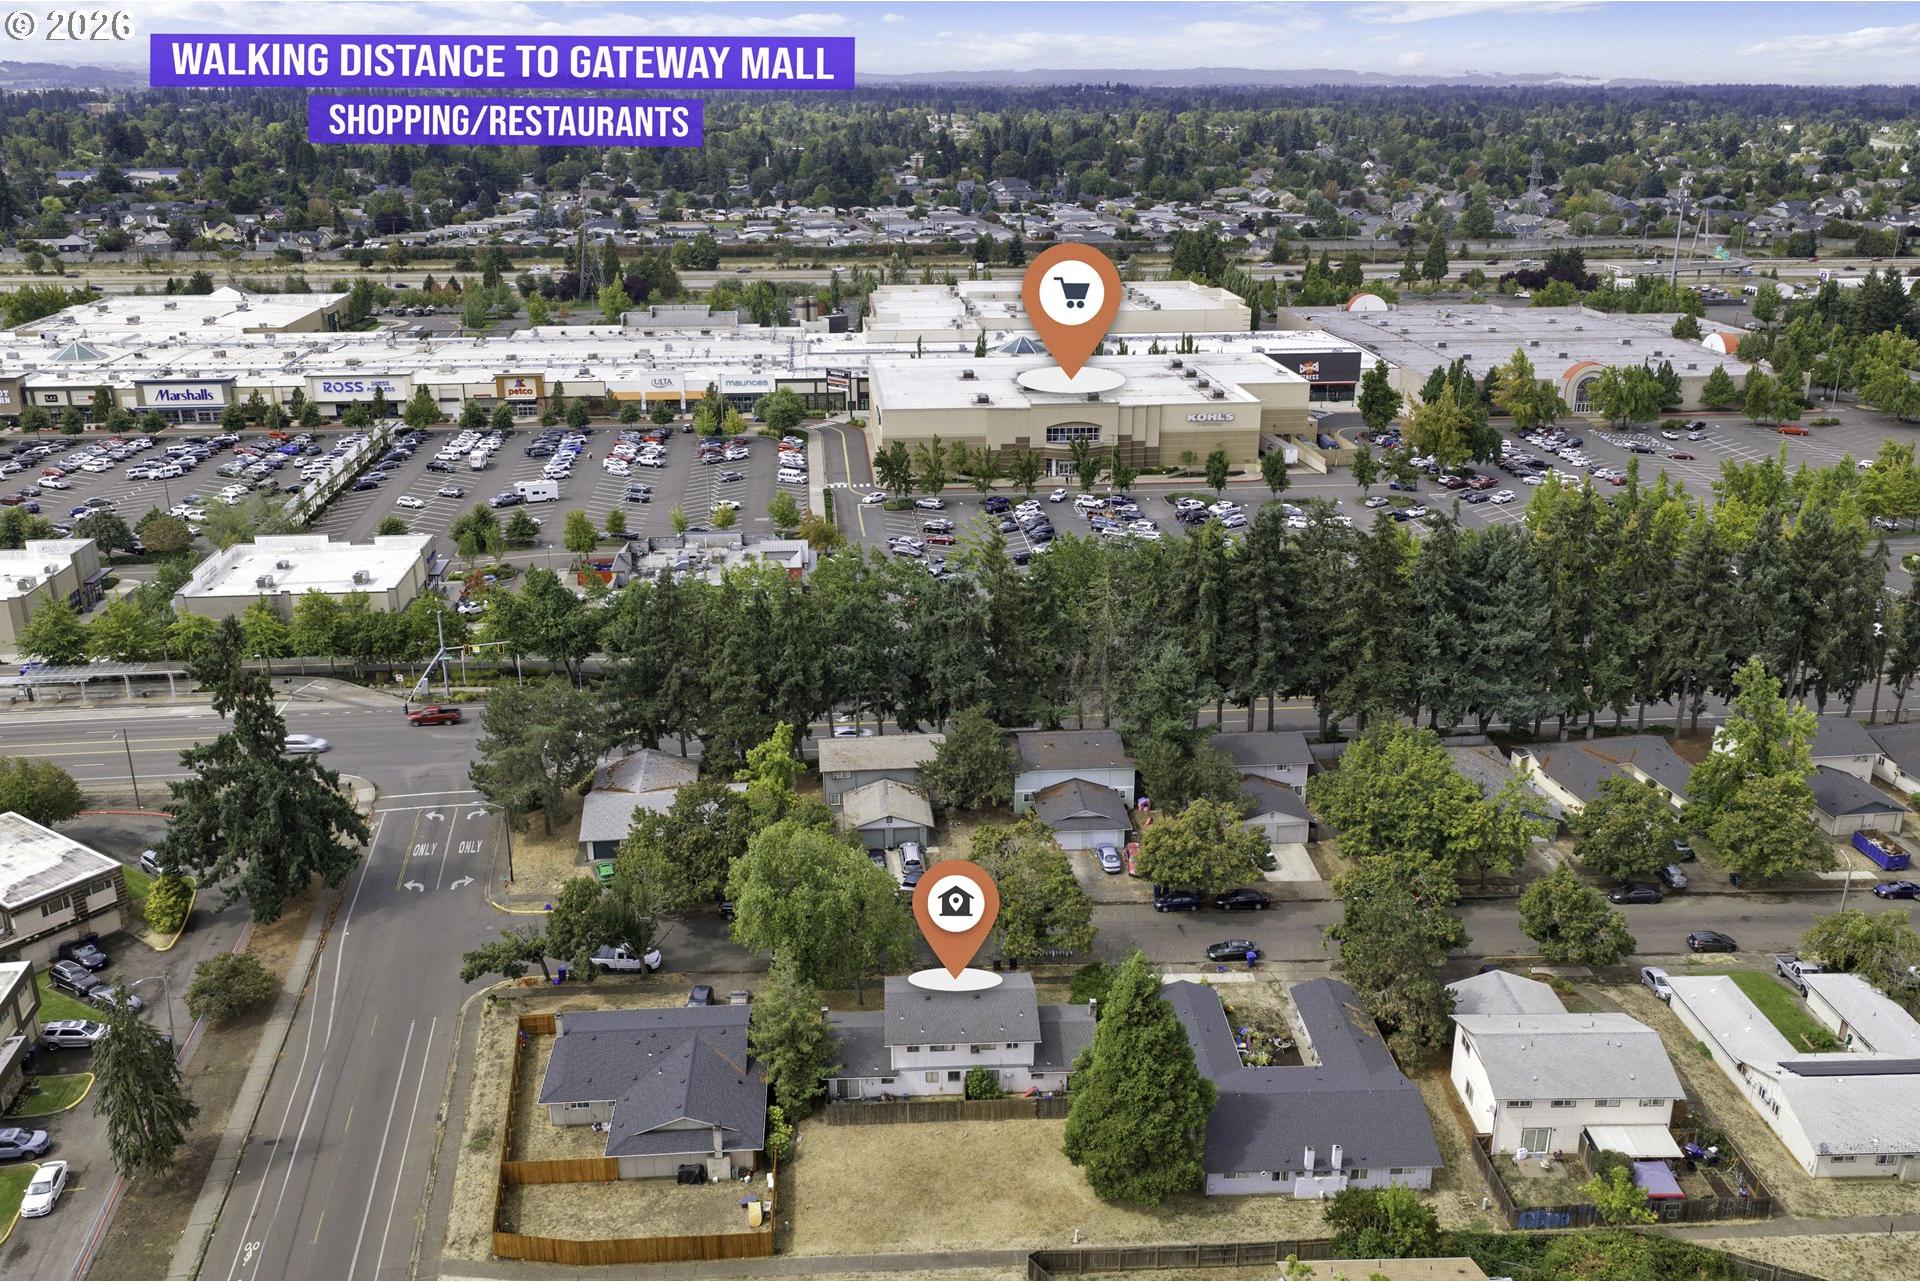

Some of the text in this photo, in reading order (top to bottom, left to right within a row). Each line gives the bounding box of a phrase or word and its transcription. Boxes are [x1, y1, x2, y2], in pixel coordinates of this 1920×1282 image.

[653, 378, 673, 386] ULTA
[726, 379, 768, 387] maurices
[323, 382, 364, 393] ROSS
[508, 388, 533, 396] petco
[155, 388, 214, 401] Marshalls
[1187, 412, 1234, 422] KOHL'S
[413, 842, 438, 856] ONLY
[459, 840, 483, 853] ONLY
